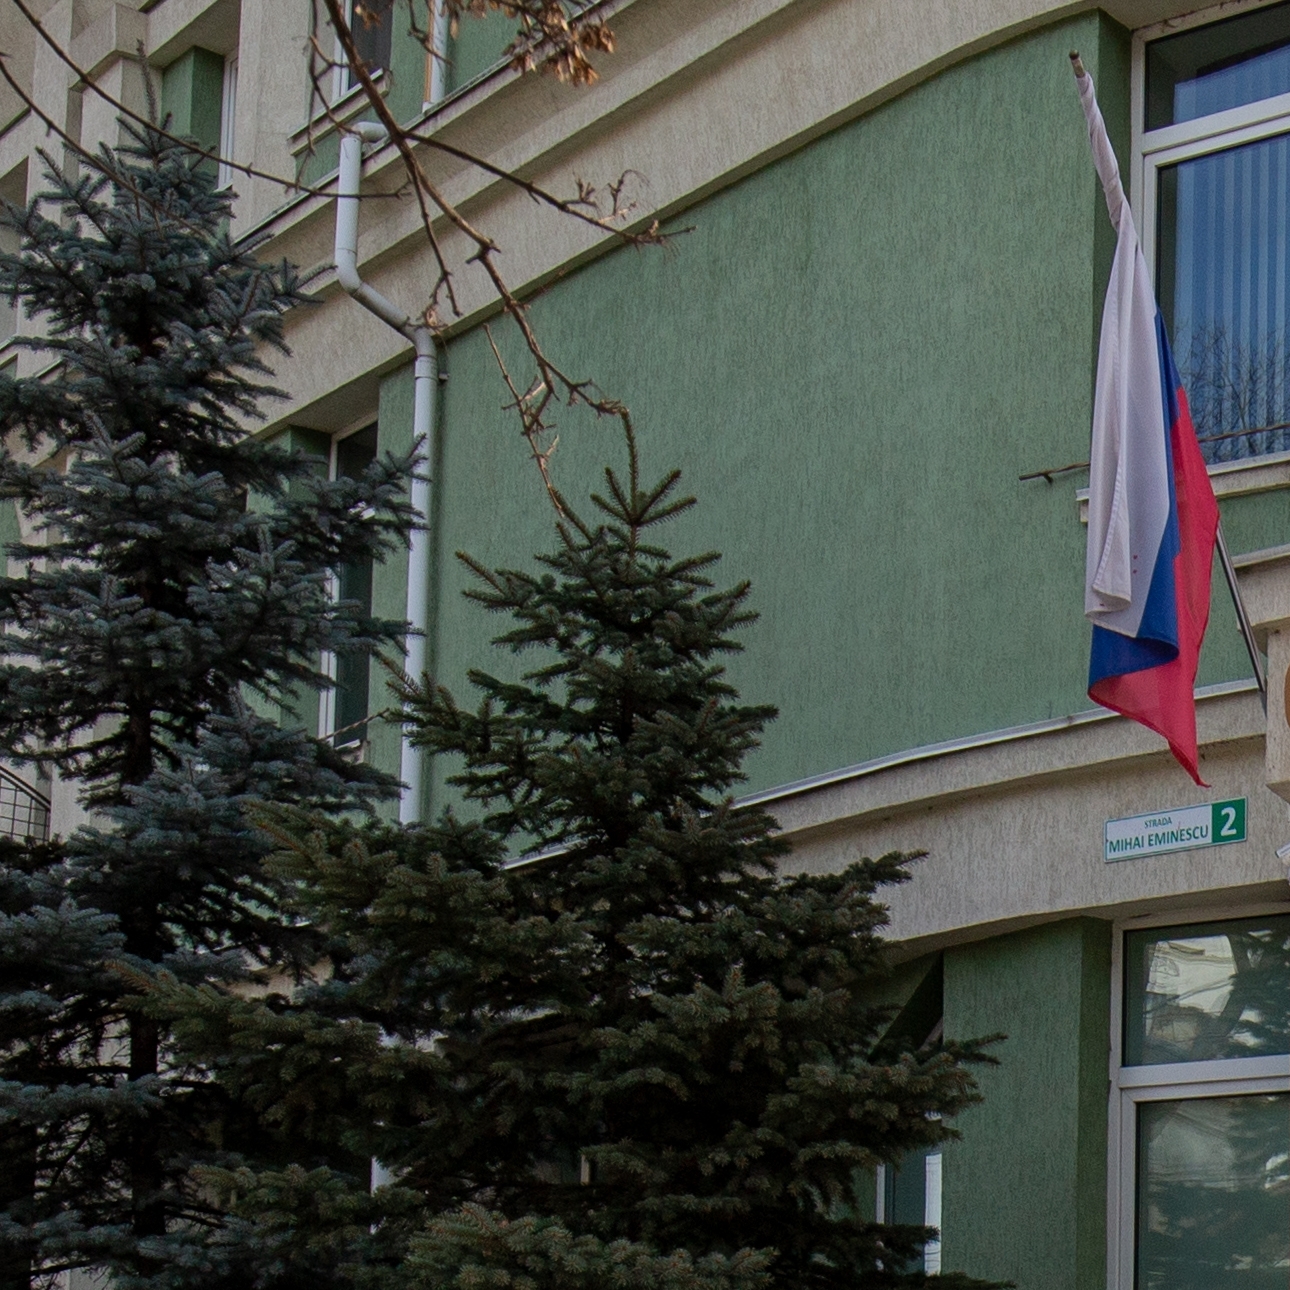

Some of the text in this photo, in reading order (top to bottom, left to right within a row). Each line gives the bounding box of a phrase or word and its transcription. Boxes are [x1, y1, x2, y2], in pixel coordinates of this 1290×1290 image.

[1144, 816, 1173, 829] STRADA
[1220, 806, 1238, 837] 2
[1109, 825, 1209, 854] MIHAI EMINESCU
